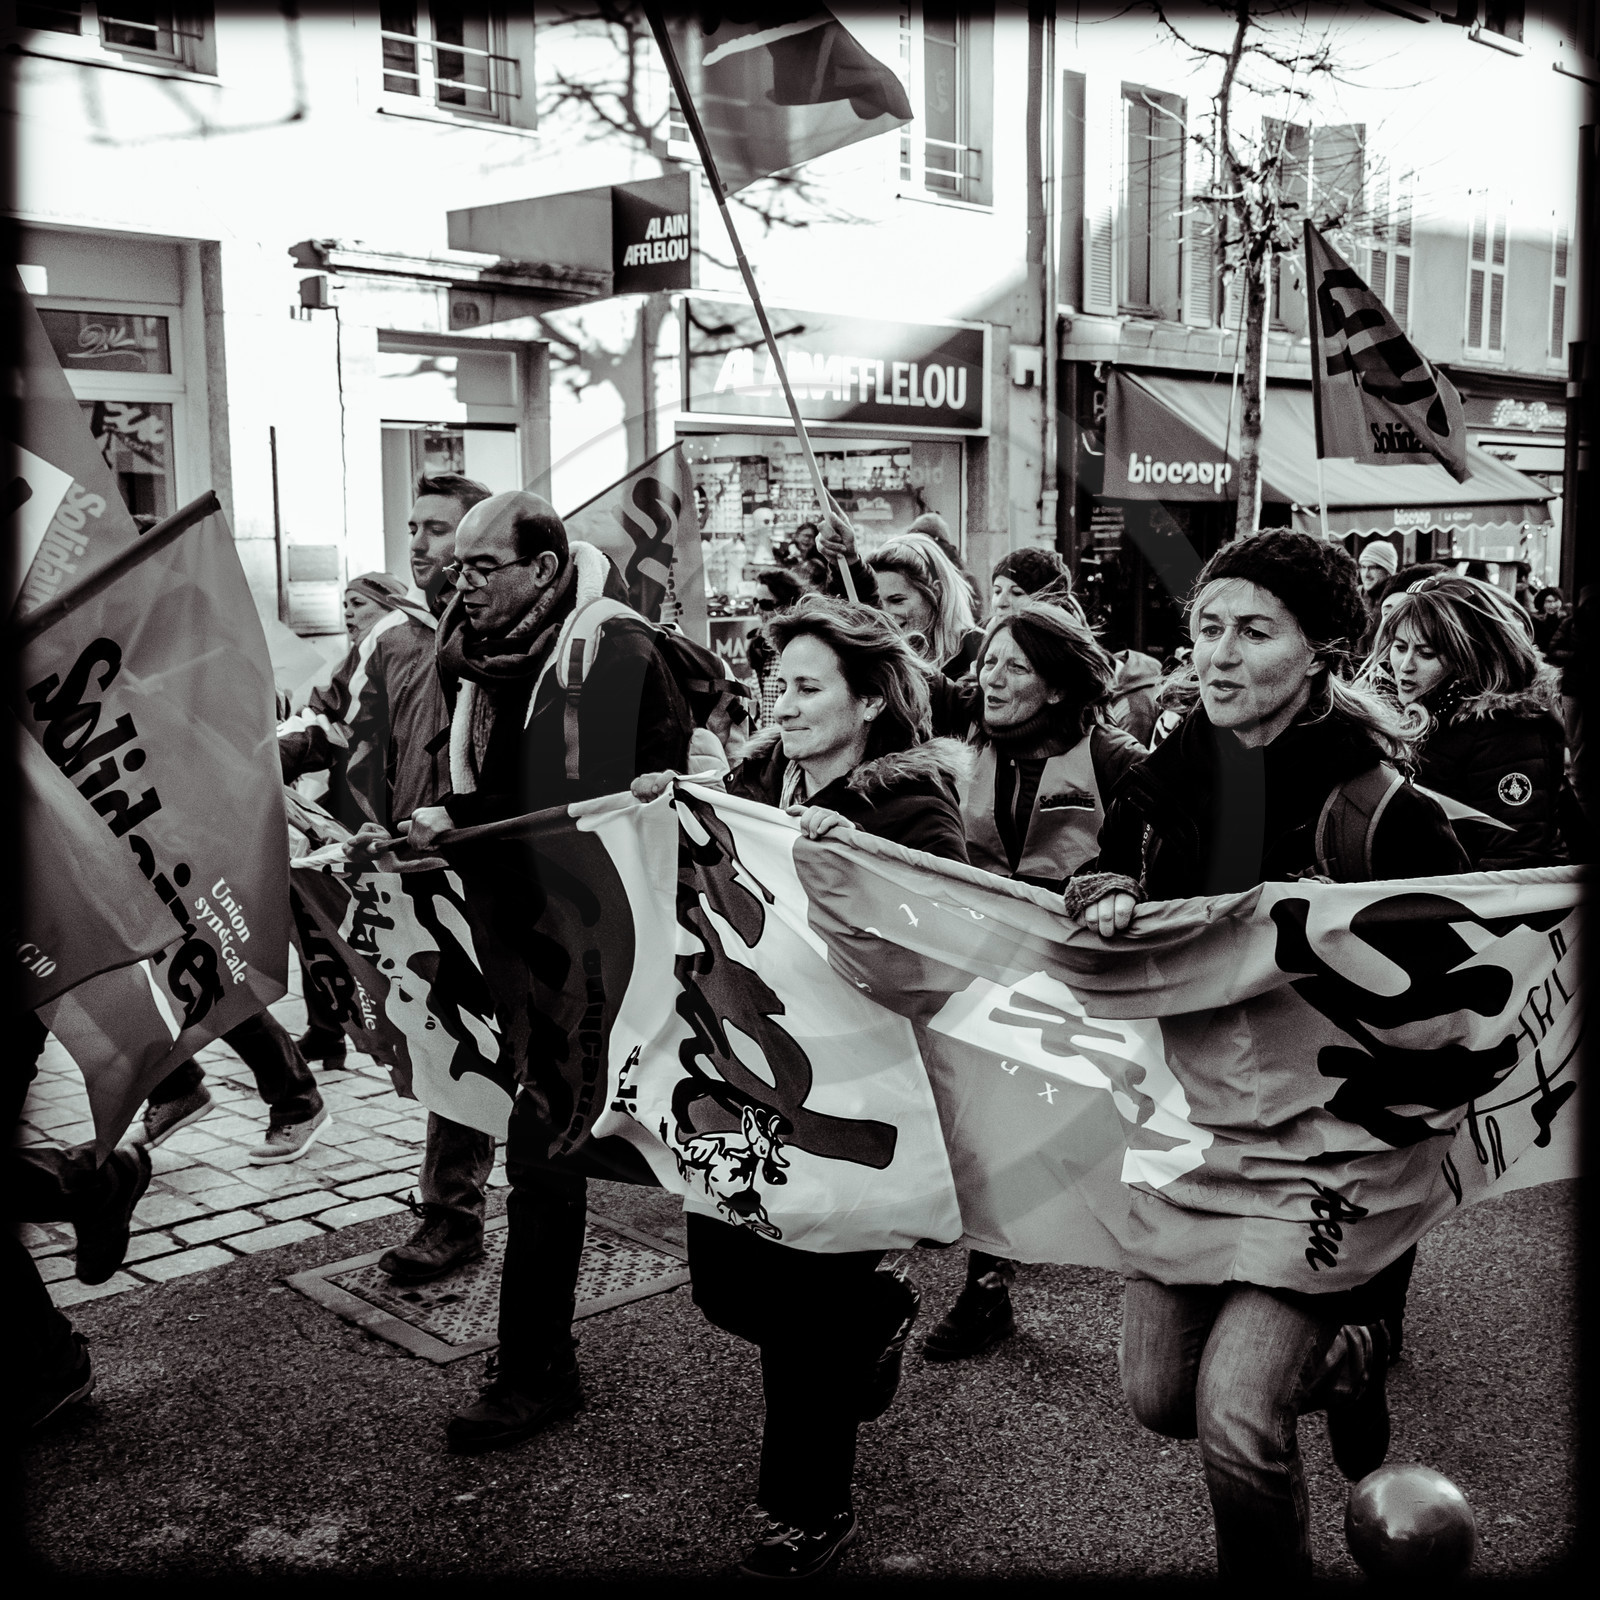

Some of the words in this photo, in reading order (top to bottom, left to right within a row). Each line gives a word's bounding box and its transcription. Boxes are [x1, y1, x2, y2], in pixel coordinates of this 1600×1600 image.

[645, 213, 688, 240] ALAIN
[623, 238, 689, 267] AFFLELOU
[814, 351, 967, 410] AFFLELOU
[1127, 452, 1232, 495] biocoop
[211, 876, 251, 944] Union
[194, 896, 249, 985] syndicale
